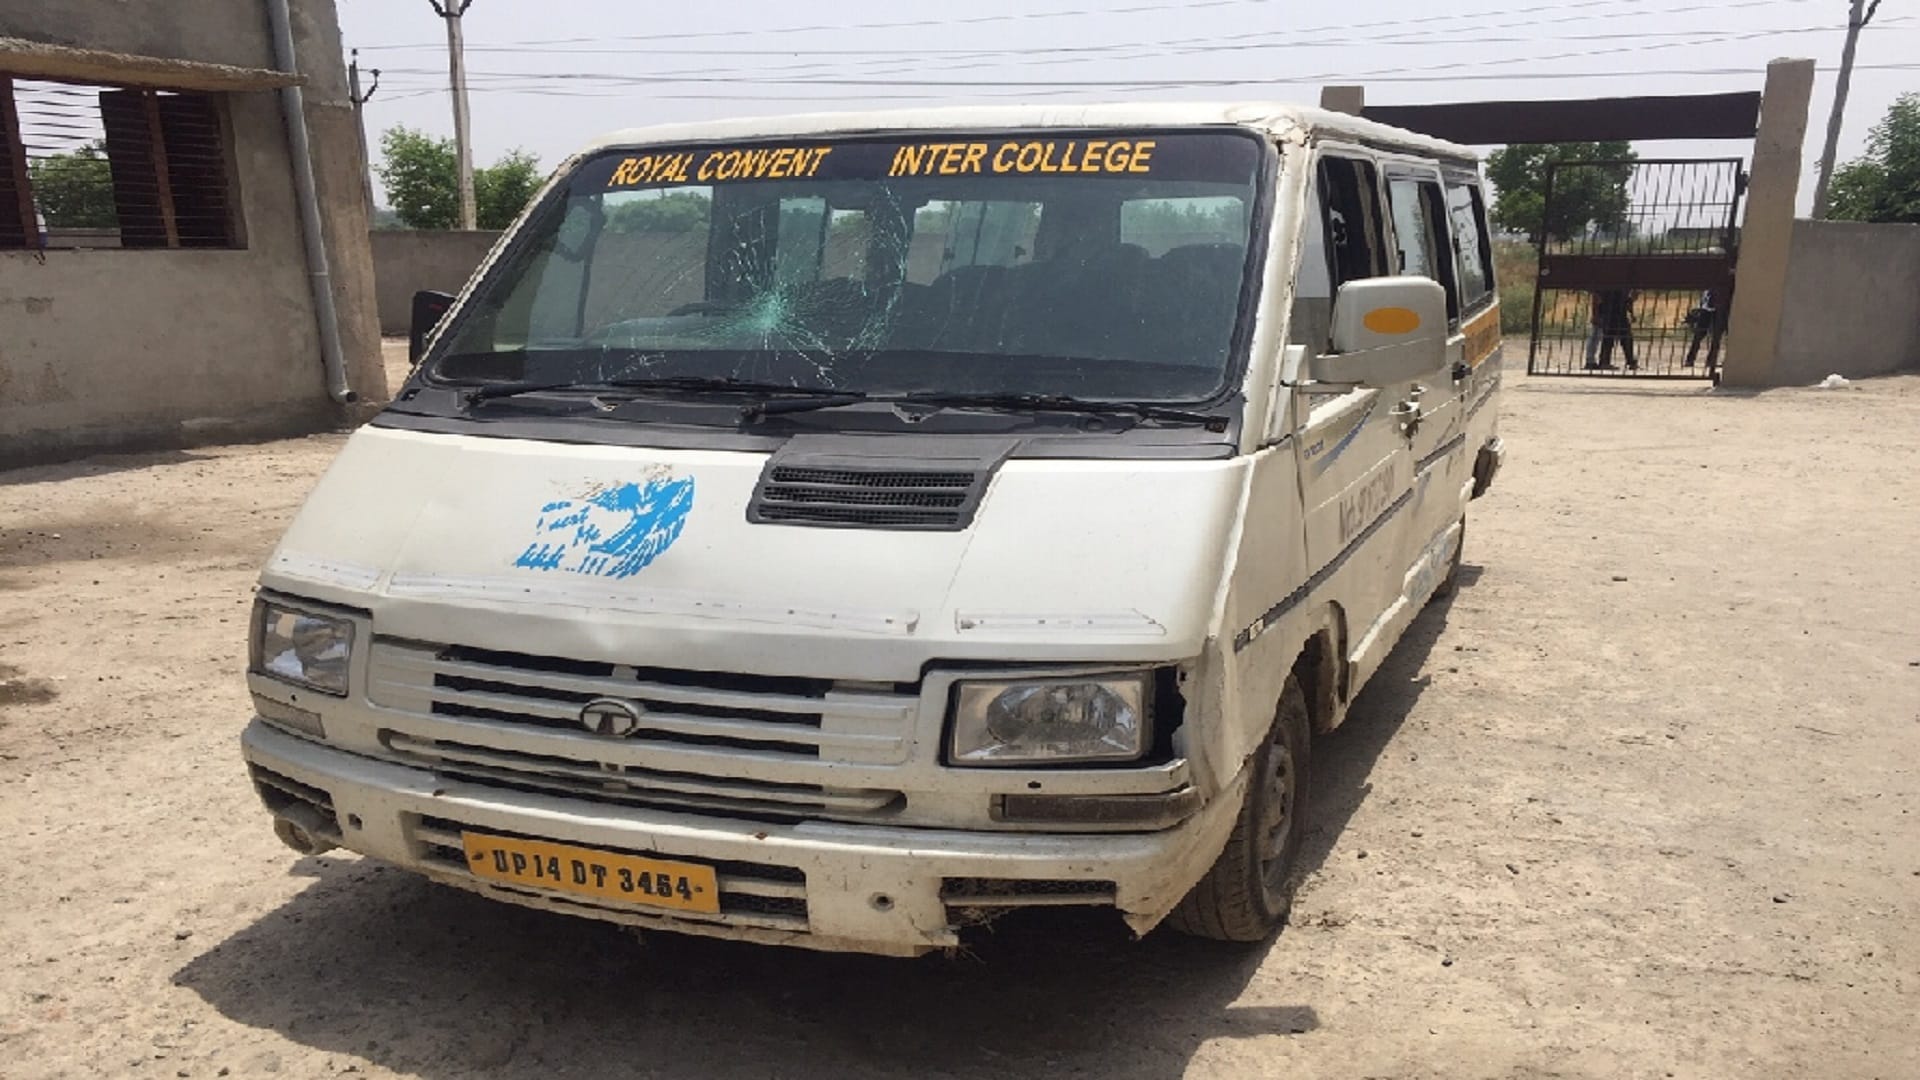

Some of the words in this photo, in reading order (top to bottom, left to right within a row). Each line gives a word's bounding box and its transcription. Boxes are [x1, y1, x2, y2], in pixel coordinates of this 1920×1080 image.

[609, 154, 693, 186] ROYAL
[698, 147, 831, 180] CONVENT
[889, 143, 987, 175] INTER
[992, 140, 1154, 172] COLLEGE
[492, 849, 561, 882] UP14
[570, 859, 607, 888] DT
